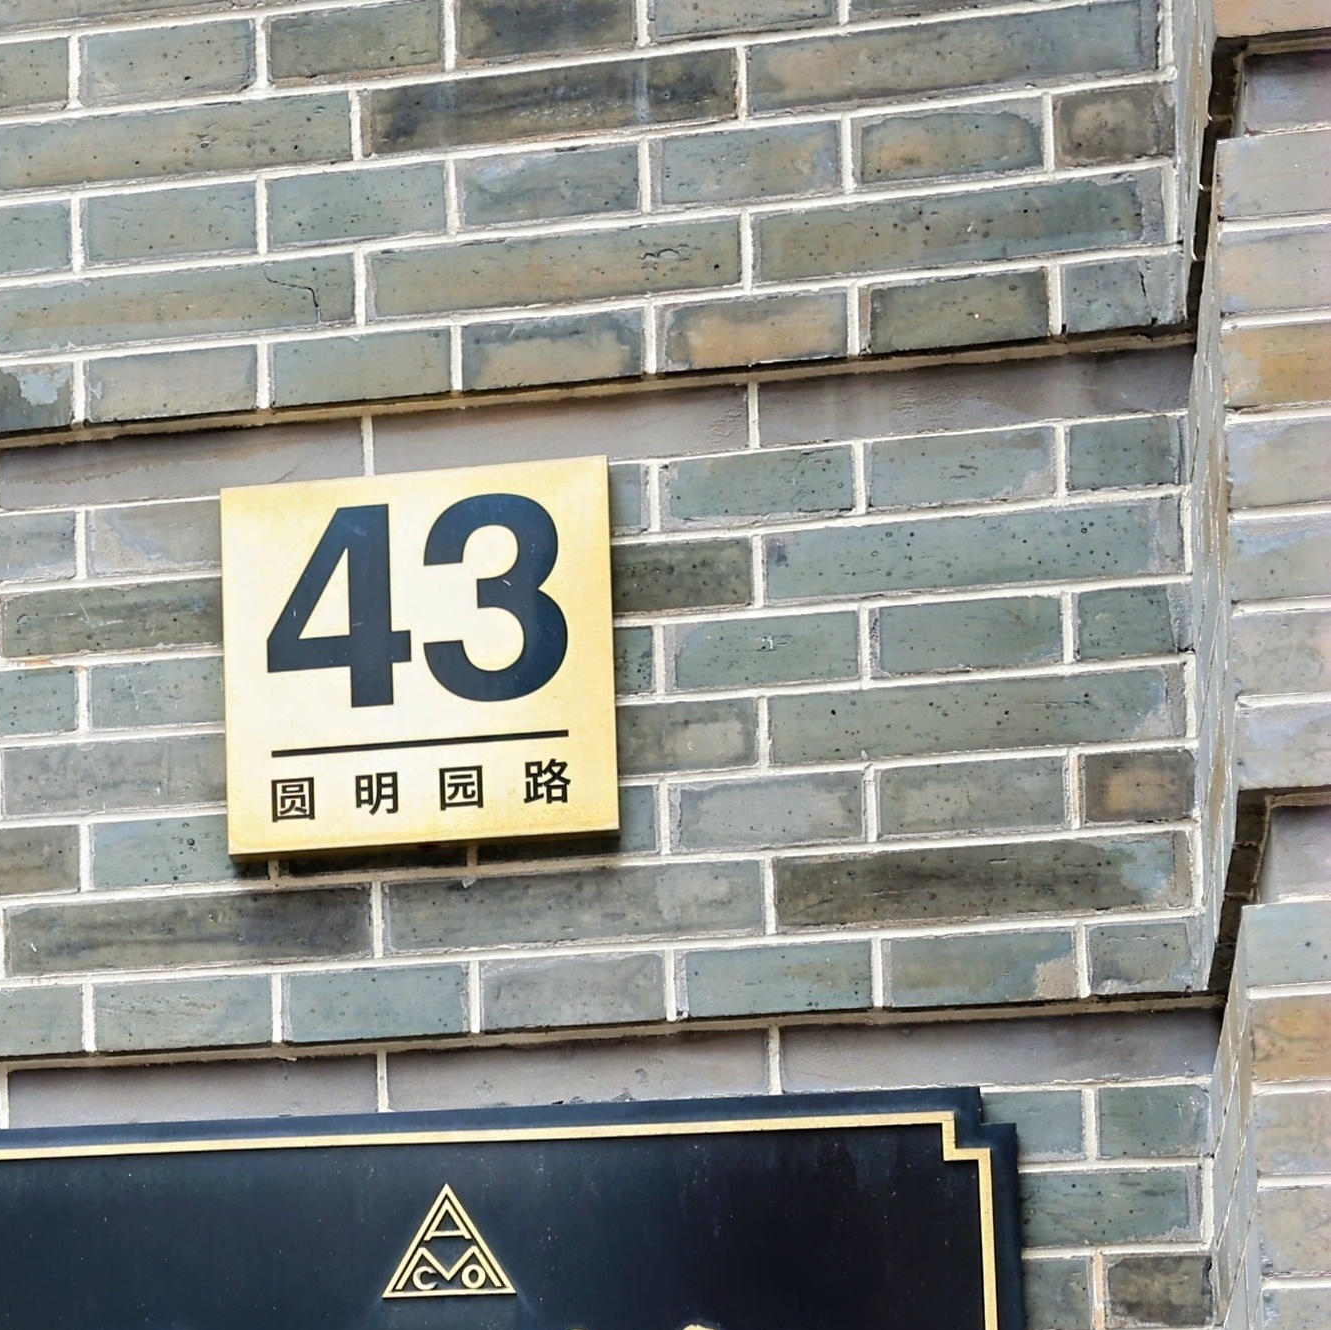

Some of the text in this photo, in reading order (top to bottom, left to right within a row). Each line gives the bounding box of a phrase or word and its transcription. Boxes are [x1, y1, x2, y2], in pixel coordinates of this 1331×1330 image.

[267, 493, 568, 708] 43
[271, 758, 571, 822] 圆明园路
